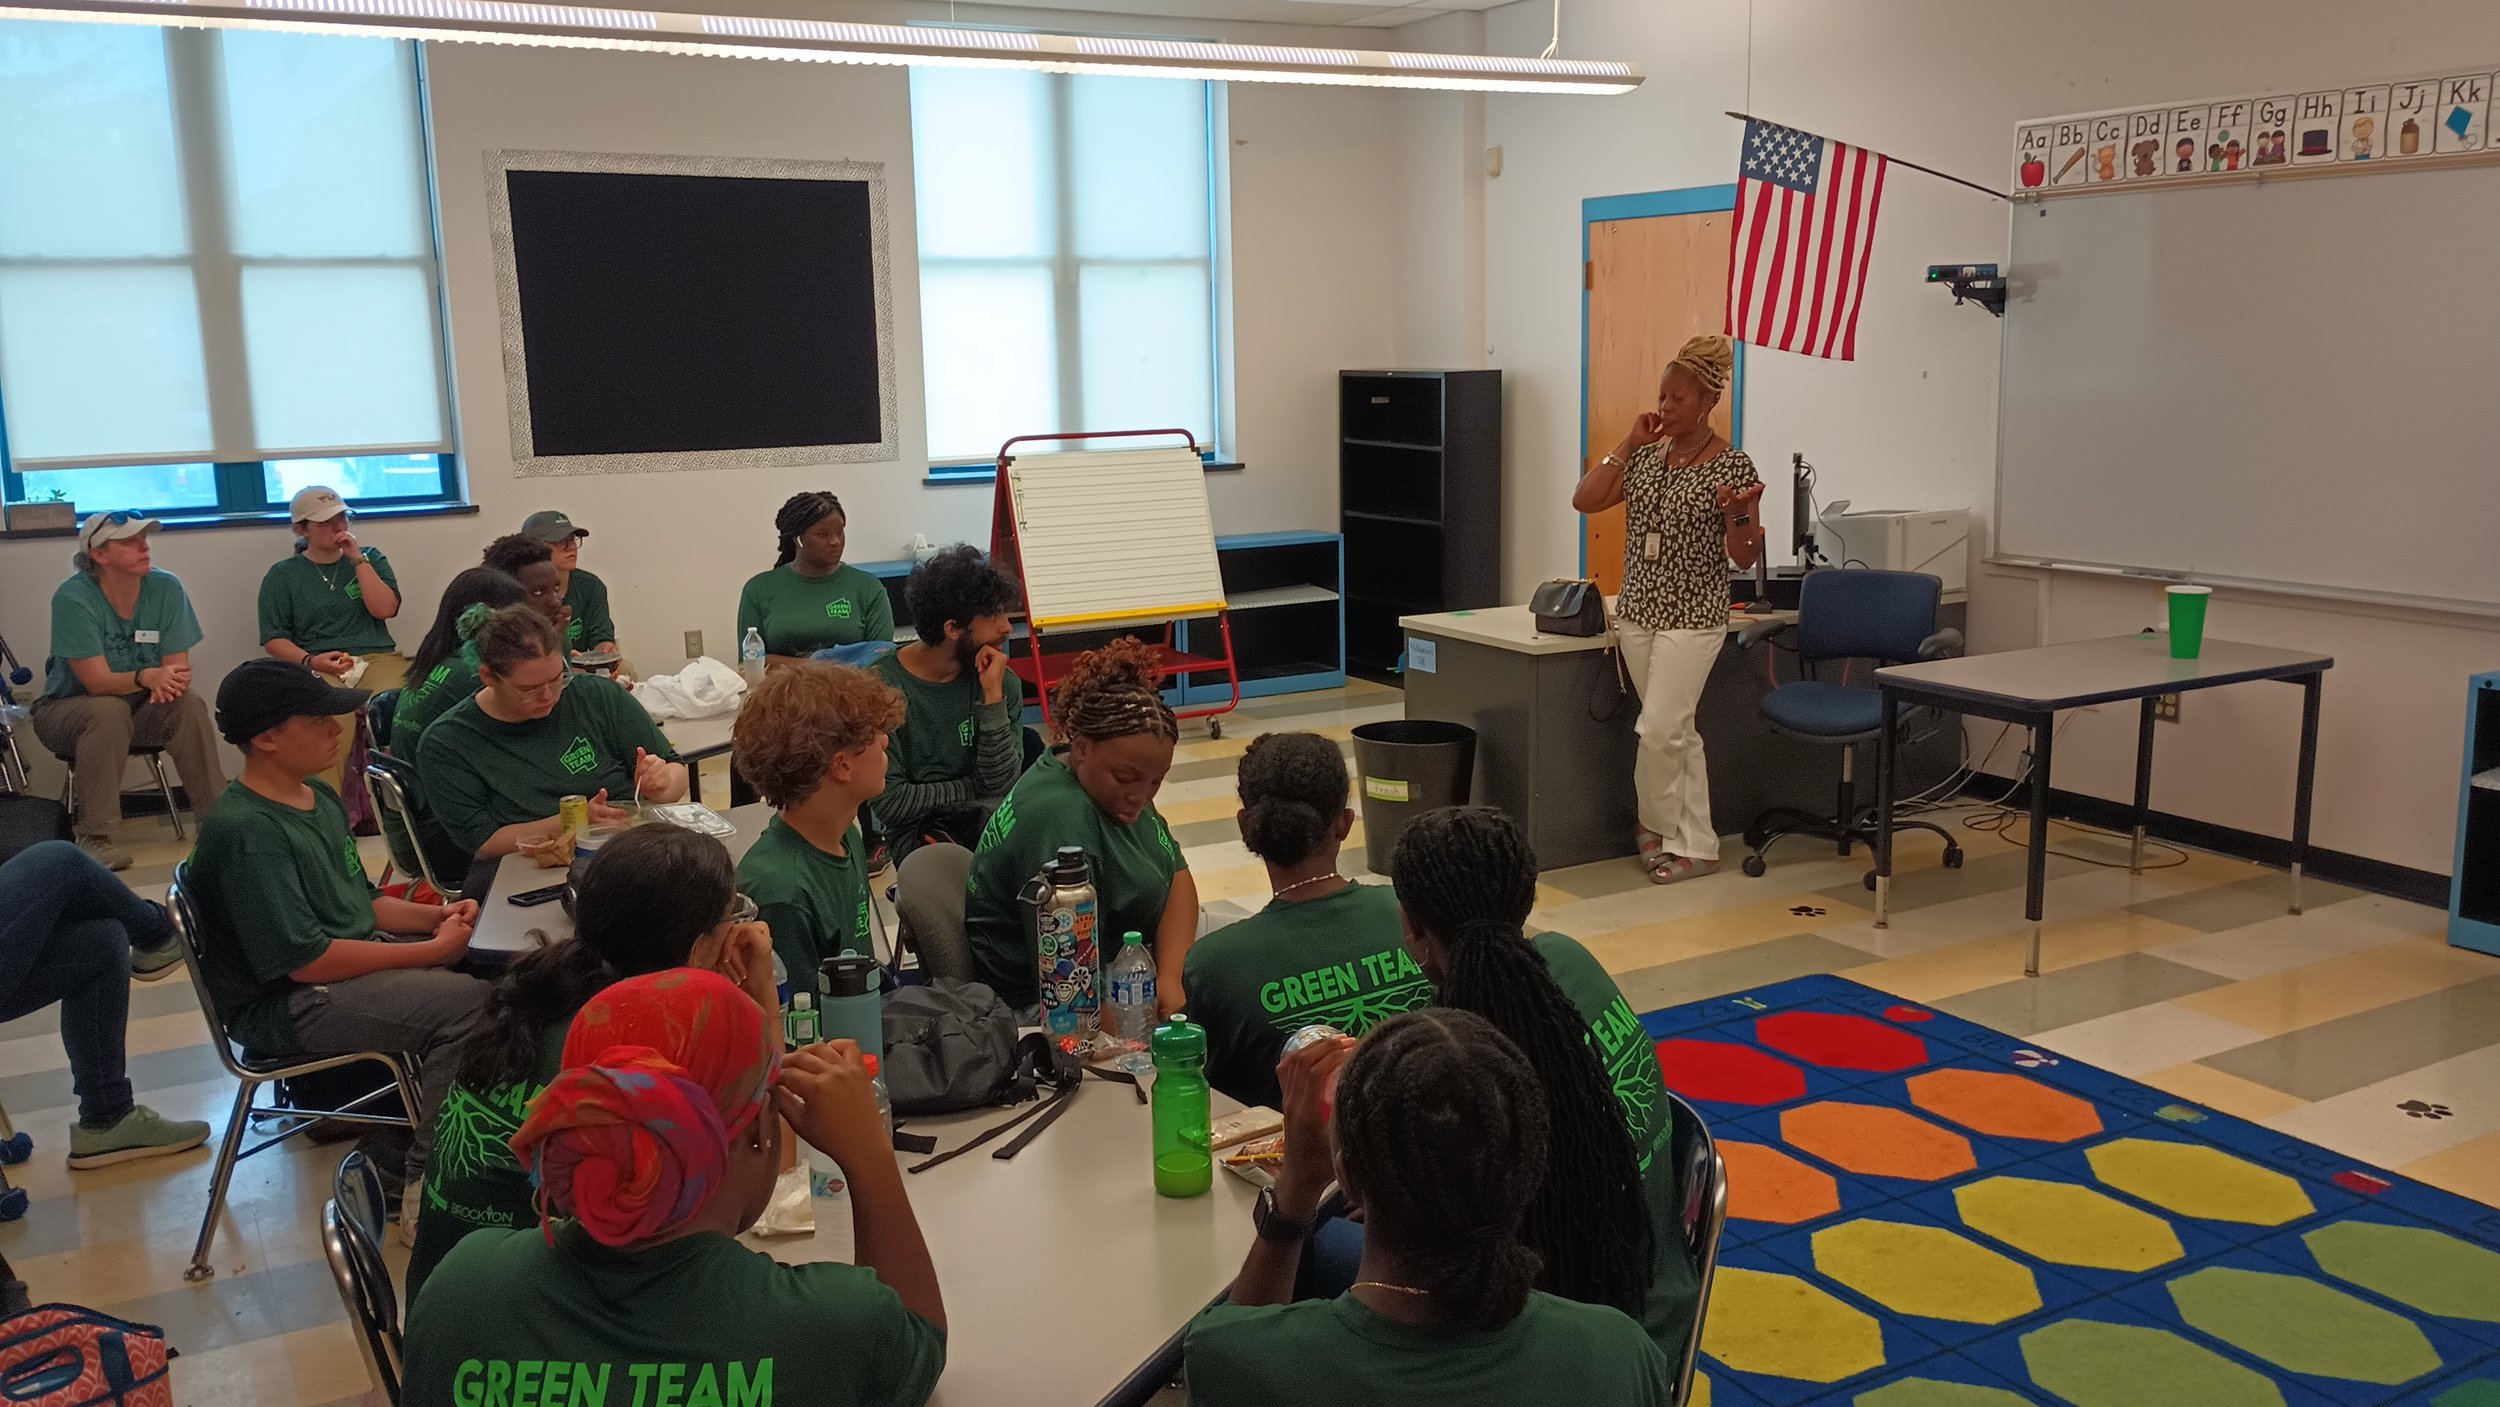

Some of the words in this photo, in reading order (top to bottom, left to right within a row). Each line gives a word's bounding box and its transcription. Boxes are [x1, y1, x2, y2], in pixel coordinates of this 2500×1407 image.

[2021, 129, 2047, 150] Aa
[2059, 124, 2083, 146] Bb
[2096, 120, 2120, 141] Cc
[2135, 112, 2161, 137] Dd
[2176, 110, 2201, 132] Ee
[2217, 104, 2243, 128] Ff
[2260, 101, 2287, 127] Gg
[2303, 95, 2333, 119] Hh
[2353, 90, 2376, 114] Ii
[2399, 85, 2425, 114] Jj
[2449, 79, 2481, 105] Kk
[563, 745, 591, 763] GREEN
[568, 754, 592, 770] TEAM
[1260, 961, 1360, 1014] GREEN
[1360, 947, 1423, 987] TEA
[1584, 994, 1640, 1064] EAM
[451, 1202, 514, 1223] BROCKTON
[453, 1358, 612, 1407] GREEN
[628, 1357, 774, 1407] TEAM
